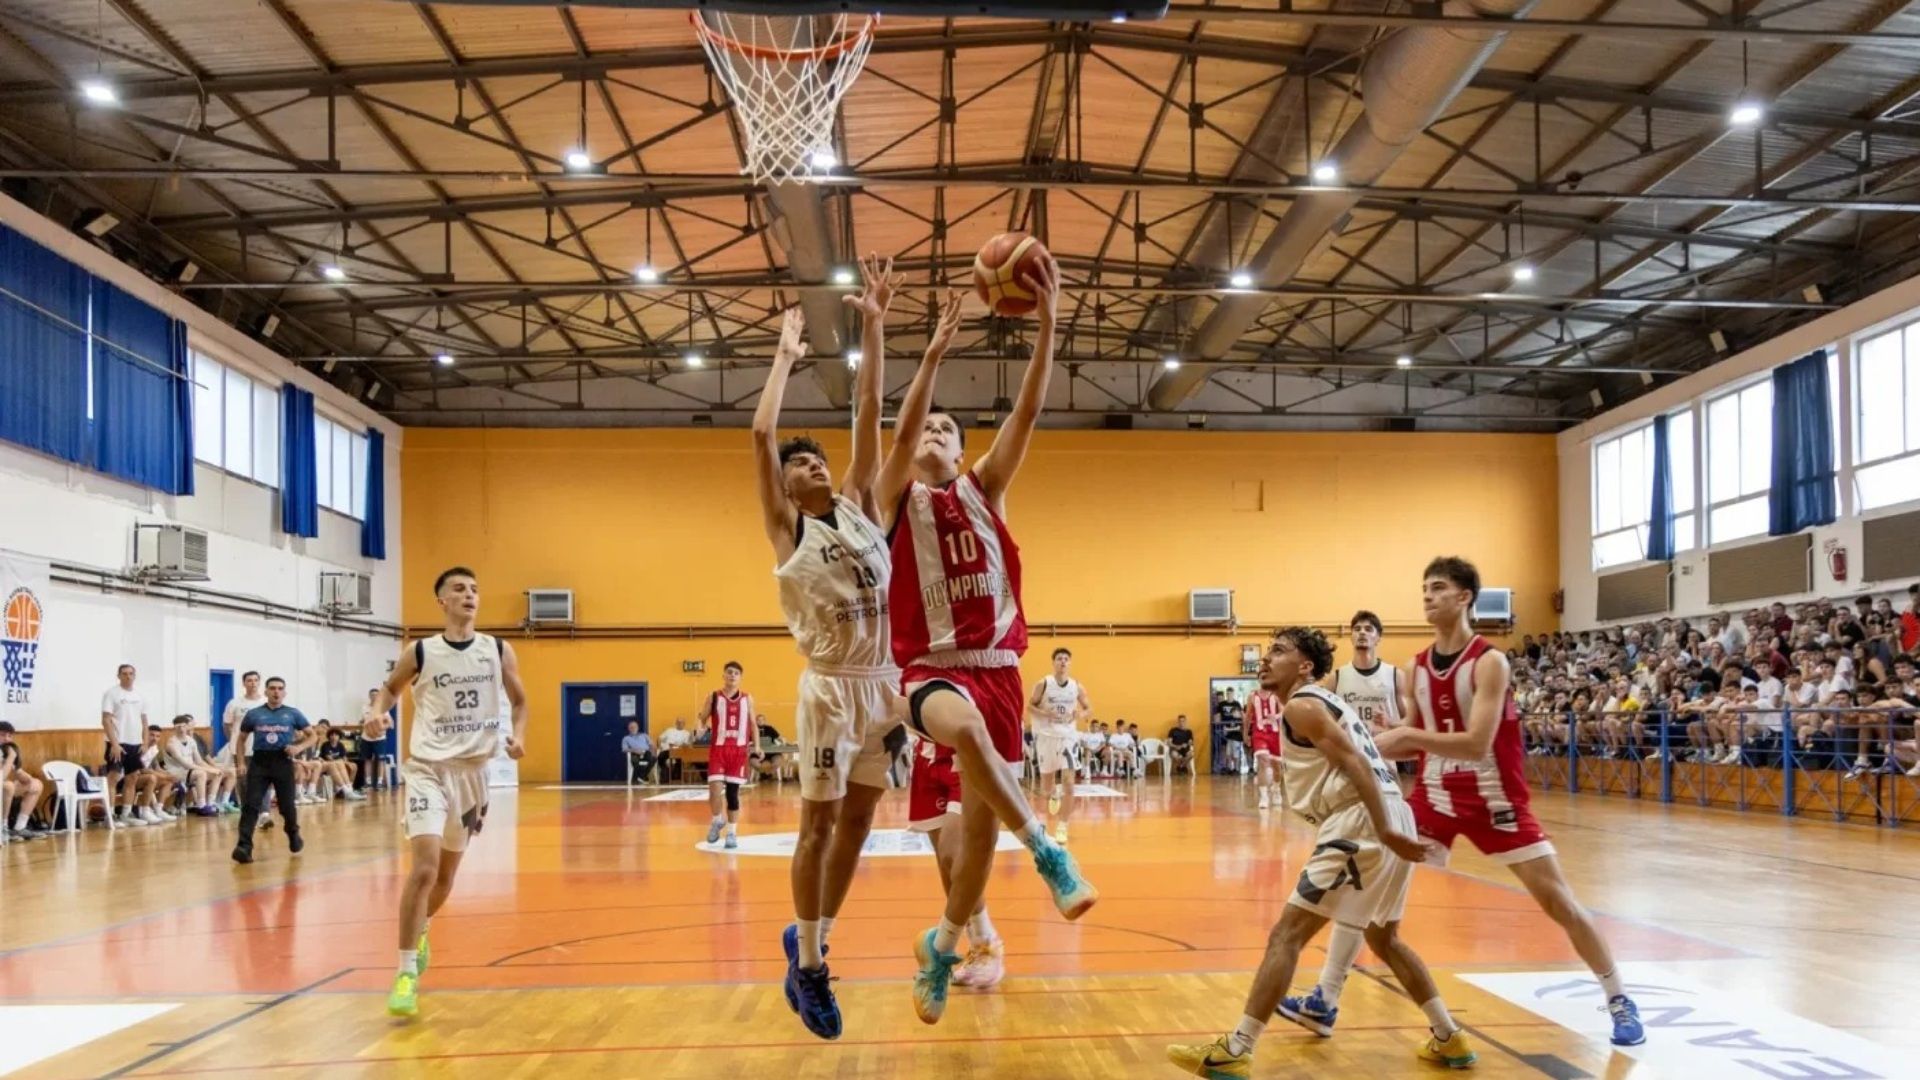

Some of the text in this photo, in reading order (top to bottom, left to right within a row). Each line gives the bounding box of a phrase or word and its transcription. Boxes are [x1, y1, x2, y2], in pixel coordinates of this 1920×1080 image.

[944, 530, 978, 565] 10
[455, 690, 479, 709] 23
[1358, 706, 1372, 720] 18
[814, 747, 835, 768] 19
[410, 797, 428, 812] 23
